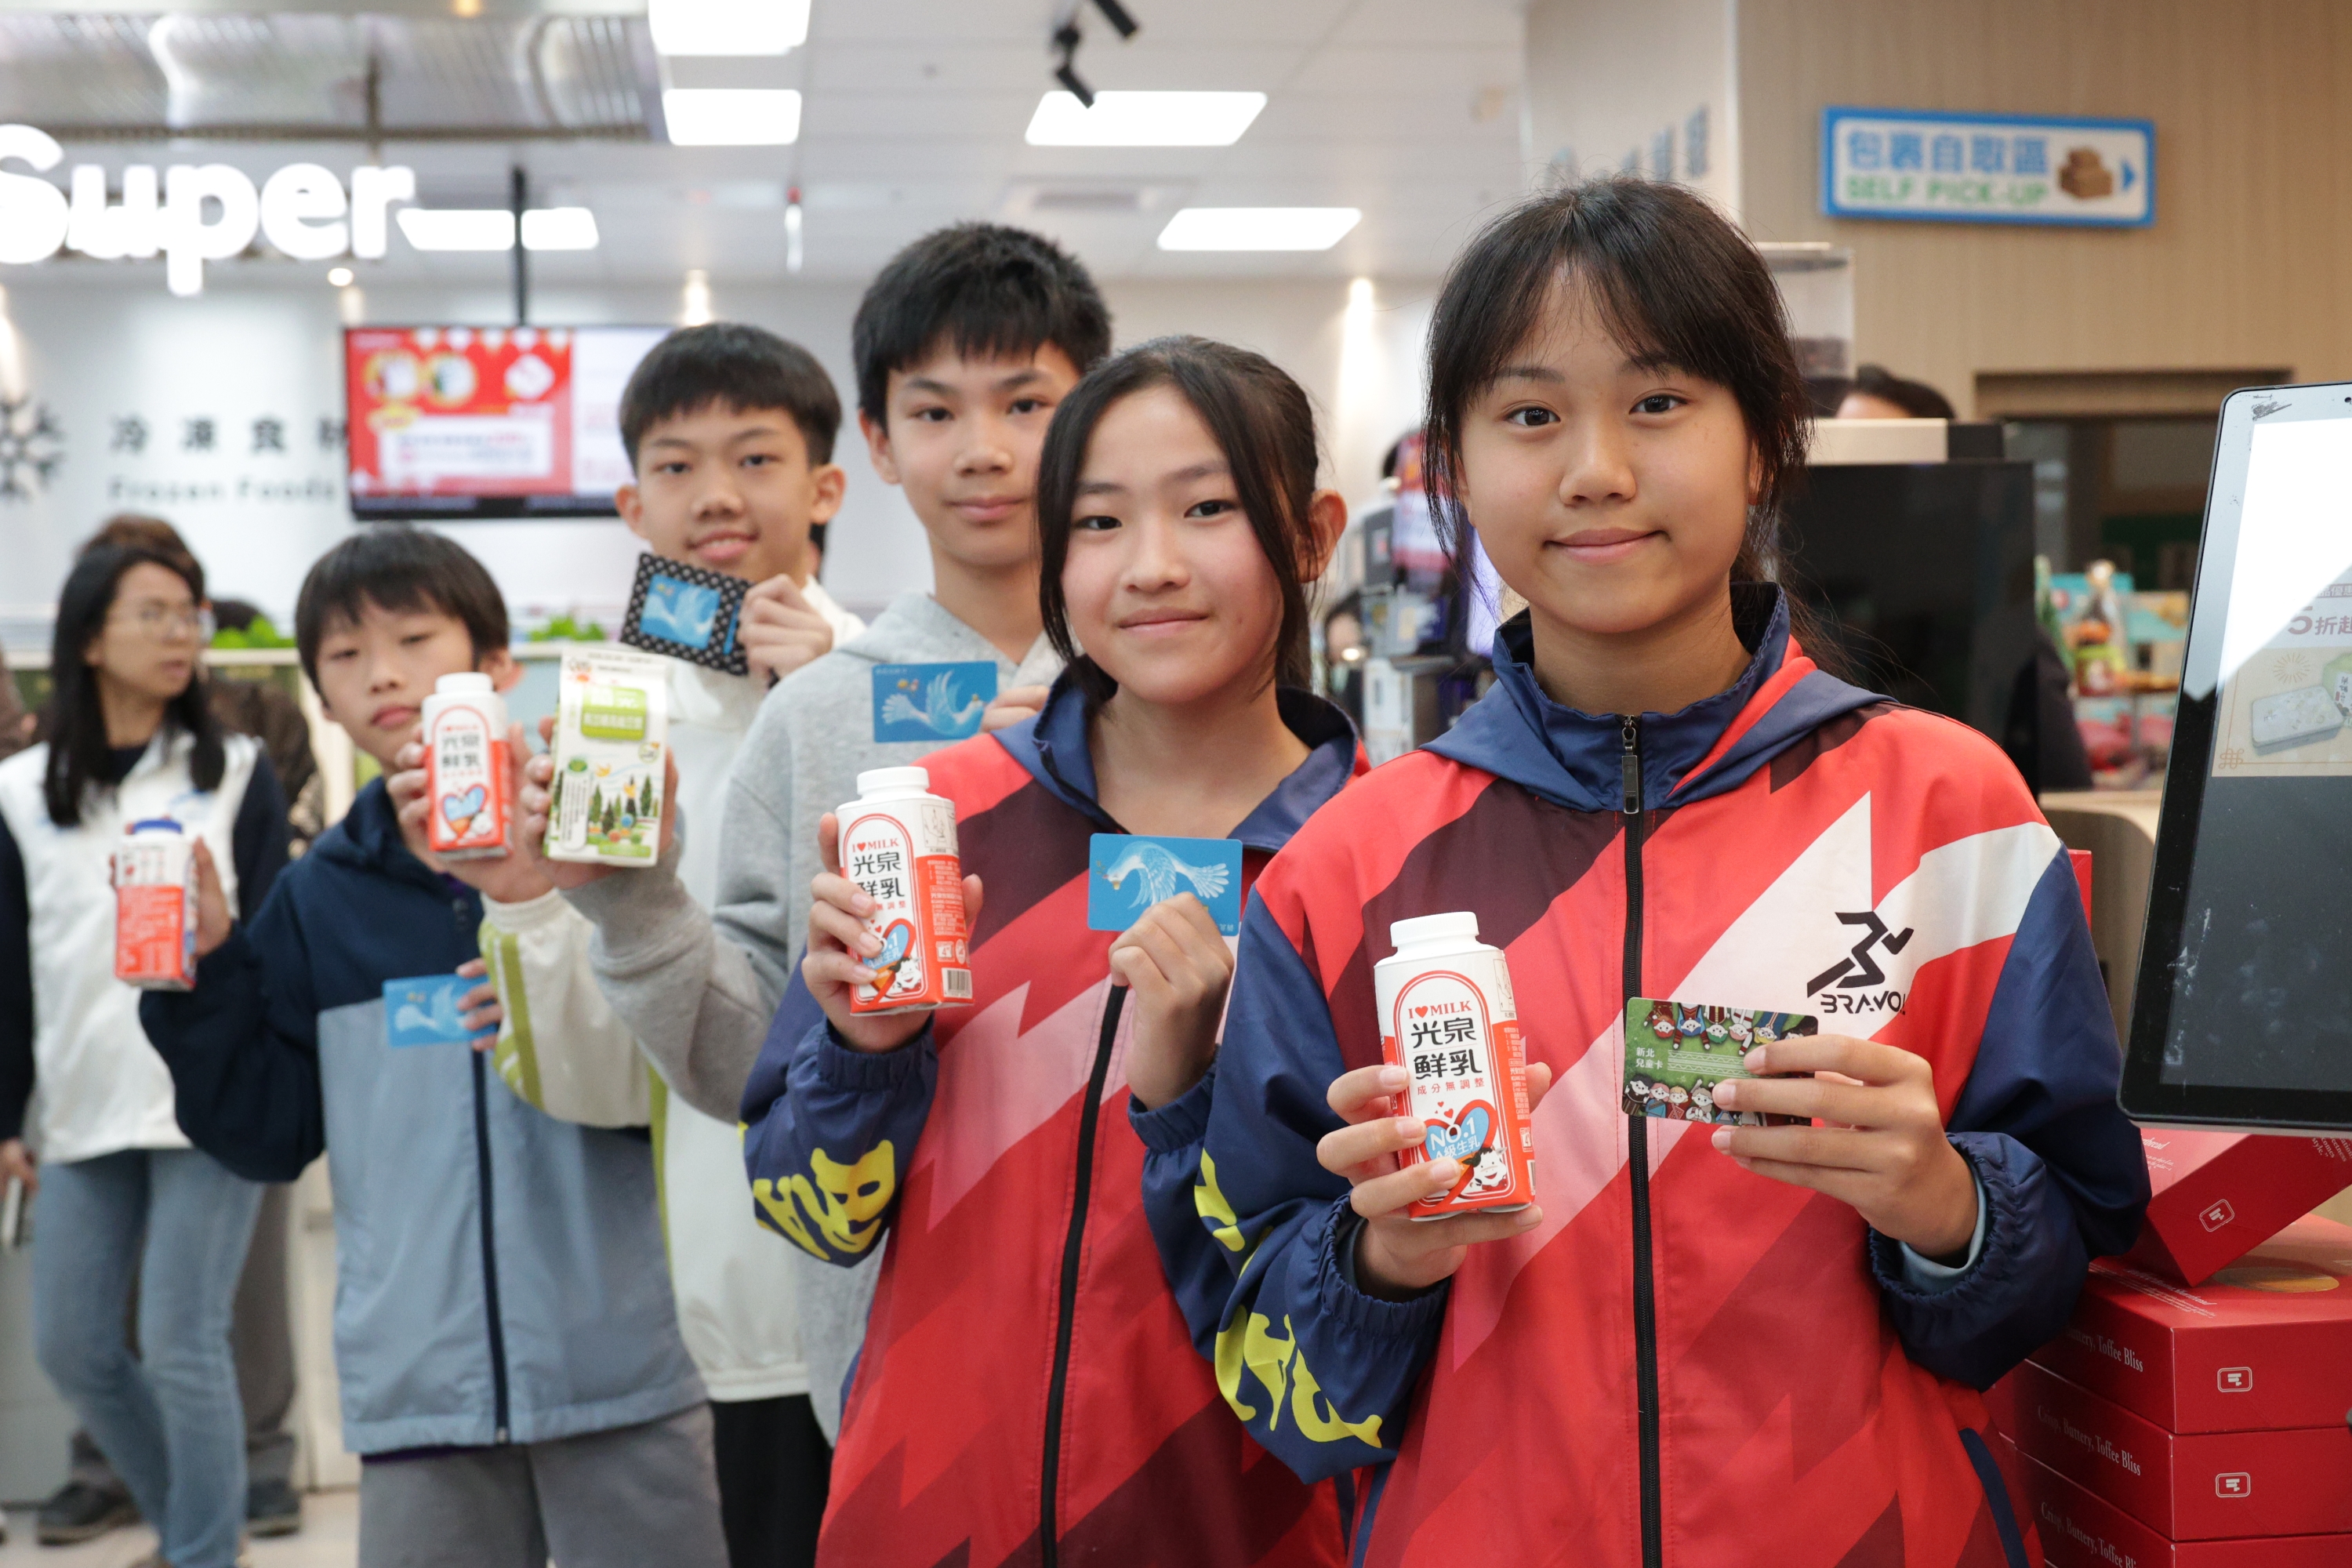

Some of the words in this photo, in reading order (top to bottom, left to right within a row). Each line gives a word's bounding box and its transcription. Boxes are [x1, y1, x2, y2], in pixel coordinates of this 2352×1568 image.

[1845, 174, 1914, 202] SELF
[0, 123, 416, 296] Super
[867, 837, 899, 851] MILK
[853, 851, 902, 877] 光泉
[1430, 1000, 1472, 1016] MILK
[1820, 990, 1906, 1016] BRAVO!
[1410, 1017, 1477, 1049] 光泉
[1414, 1048, 1483, 1080] 鮮乳
[1635, 1058, 1664, 1070] 兒童卡
[1636, 1047, 1655, 1058] 新北
[1417, 1077, 1485, 1096] 成分無調整
[1430, 1116, 1475, 1151] NO.1
[2096, 1334, 2122, 1362] Toffee
[2123, 1347, 2144, 1373] Bliss
[2063, 1417, 2094, 1452] Buttery,
[2094, 1435, 2120, 1464] Toffee
[2121, 1450, 2141, 1476] Bliss
[2065, 1516, 2097, 1555] Buttery,
[2097, 1537, 2123, 1568] Toffee
